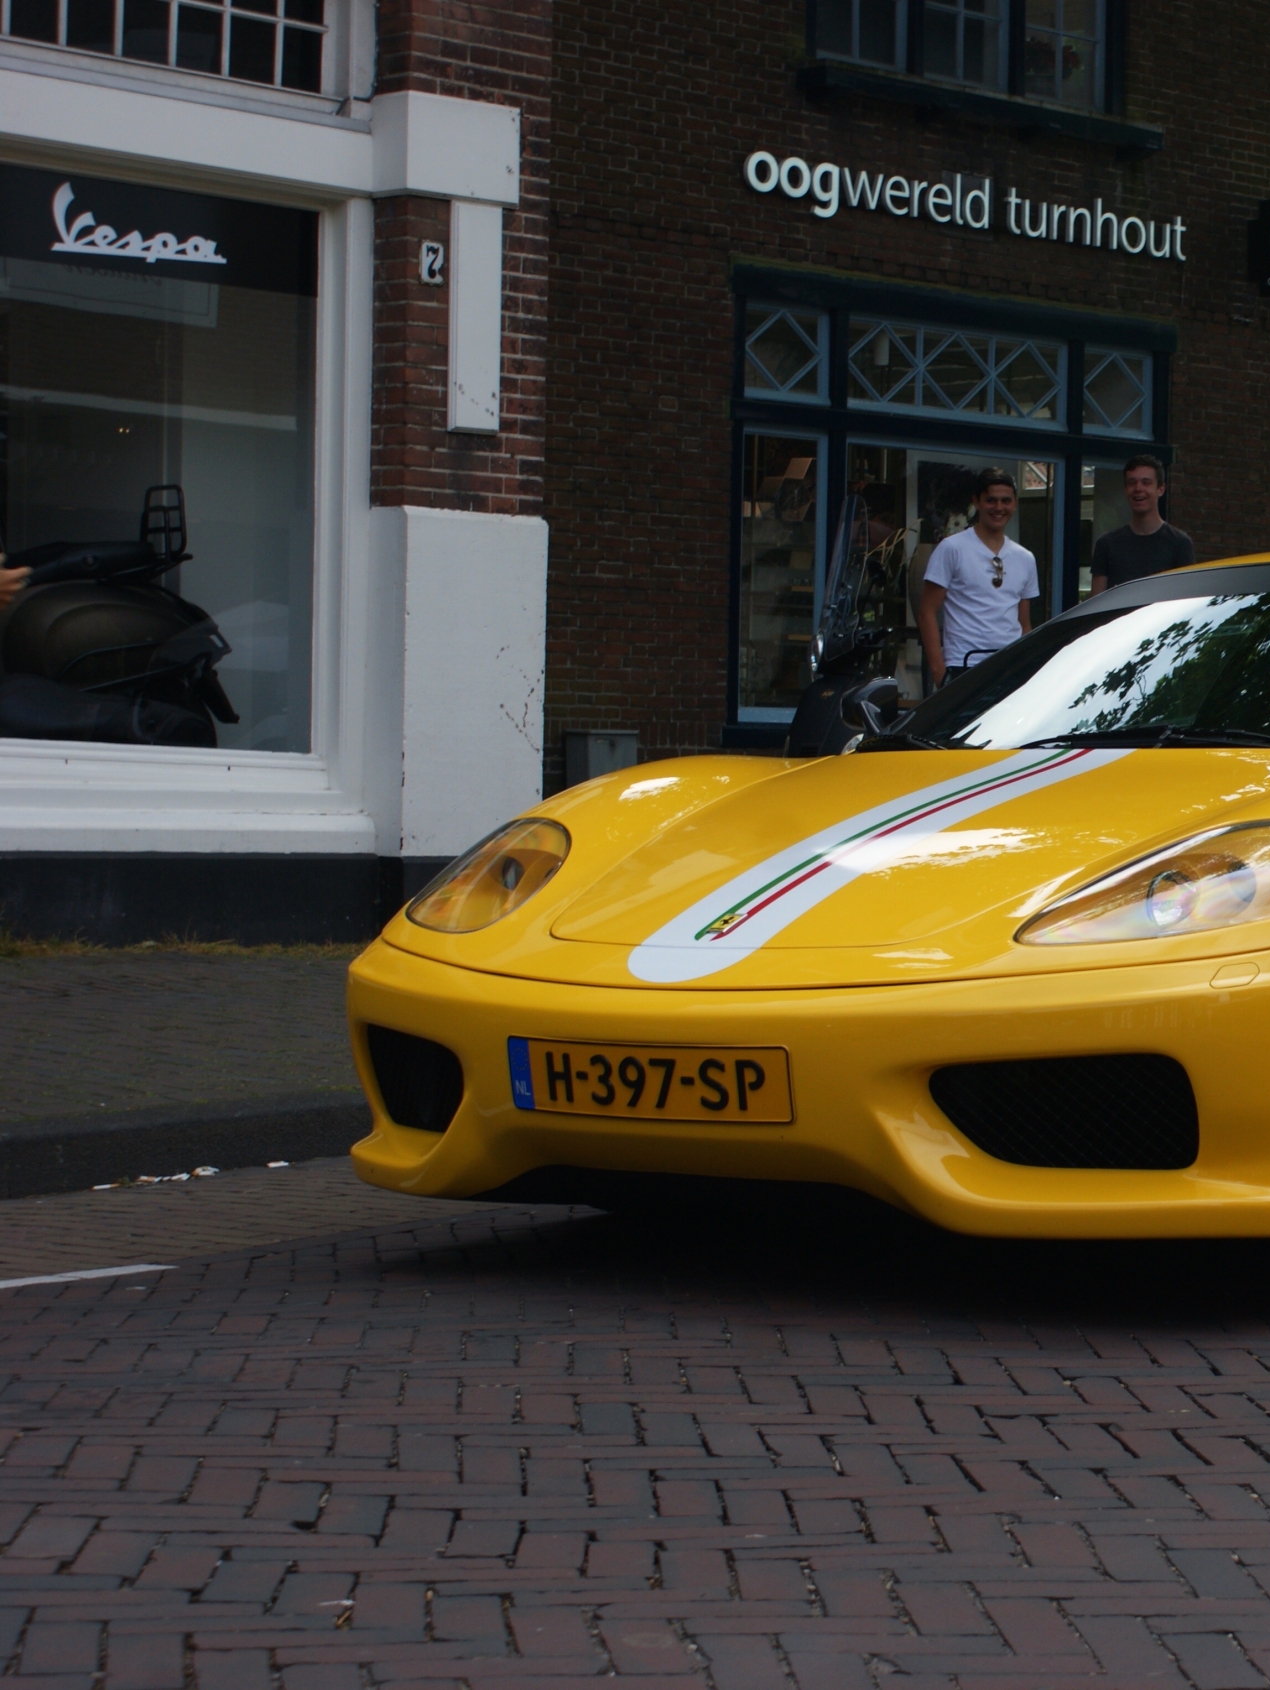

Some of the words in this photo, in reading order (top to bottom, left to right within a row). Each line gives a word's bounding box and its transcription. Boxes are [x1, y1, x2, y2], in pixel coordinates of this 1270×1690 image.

[51, 181, 227, 264] Vespa
[745, 150, 990, 229] oogwereld
[1005, 187, 1186, 261] turnhout
[426, 245, 440, 280] 7
[515, 1079, 531, 1096] NL
[545, 1051, 765, 1112] H-397-SP
